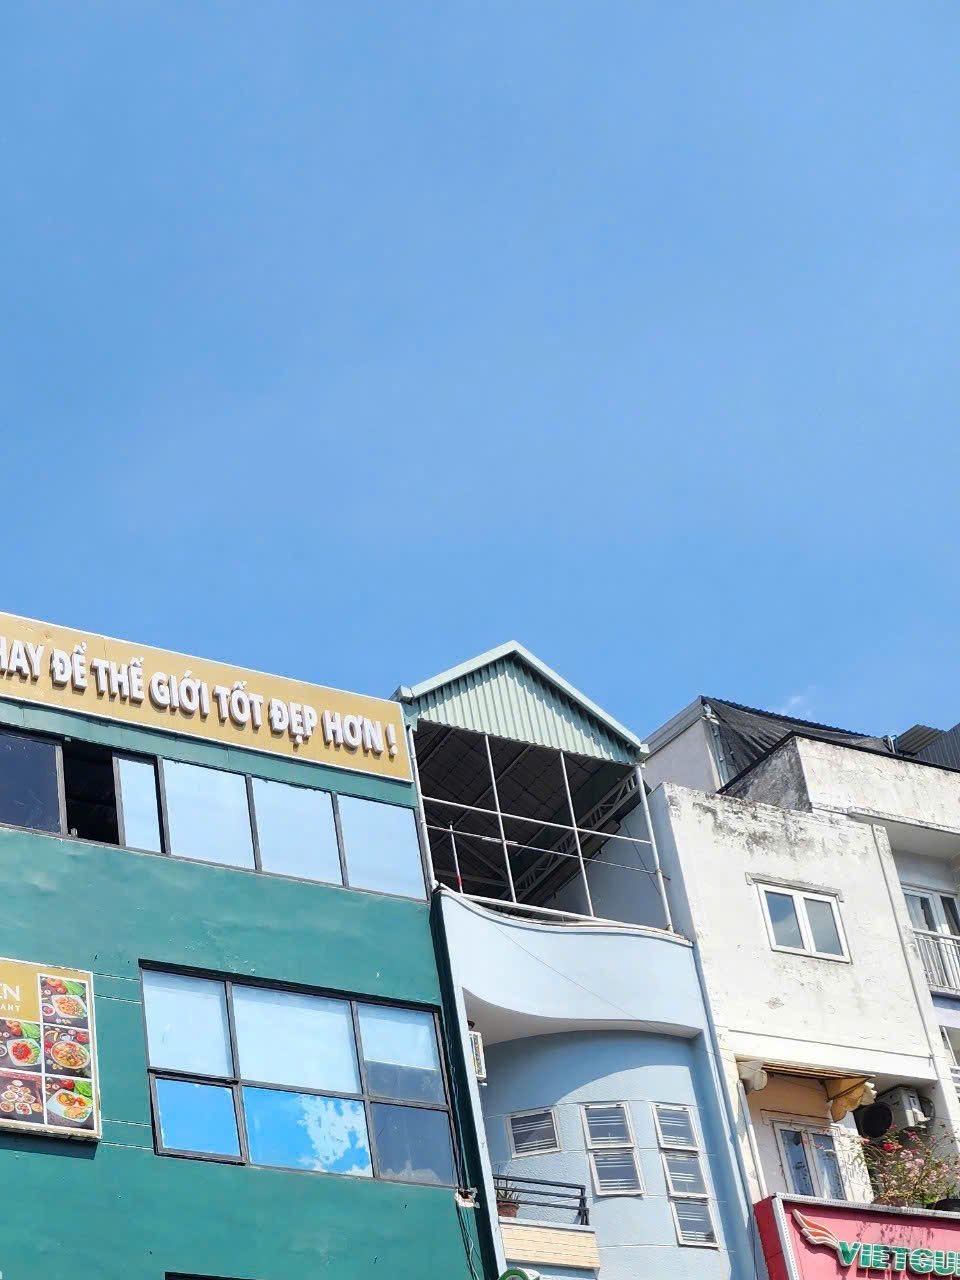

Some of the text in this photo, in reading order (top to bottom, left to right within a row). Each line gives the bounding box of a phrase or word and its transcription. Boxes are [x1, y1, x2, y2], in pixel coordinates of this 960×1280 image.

[51, 641, 88, 690] ĐỂ
[91, 657, 144, 702] THẾ
[149, 670, 209, 716] GIỚI
[213, 681, 264, 728] TỐT
[269, 698, 317, 745] ĐẸP
[322, 710, 384, 755] HƠN
